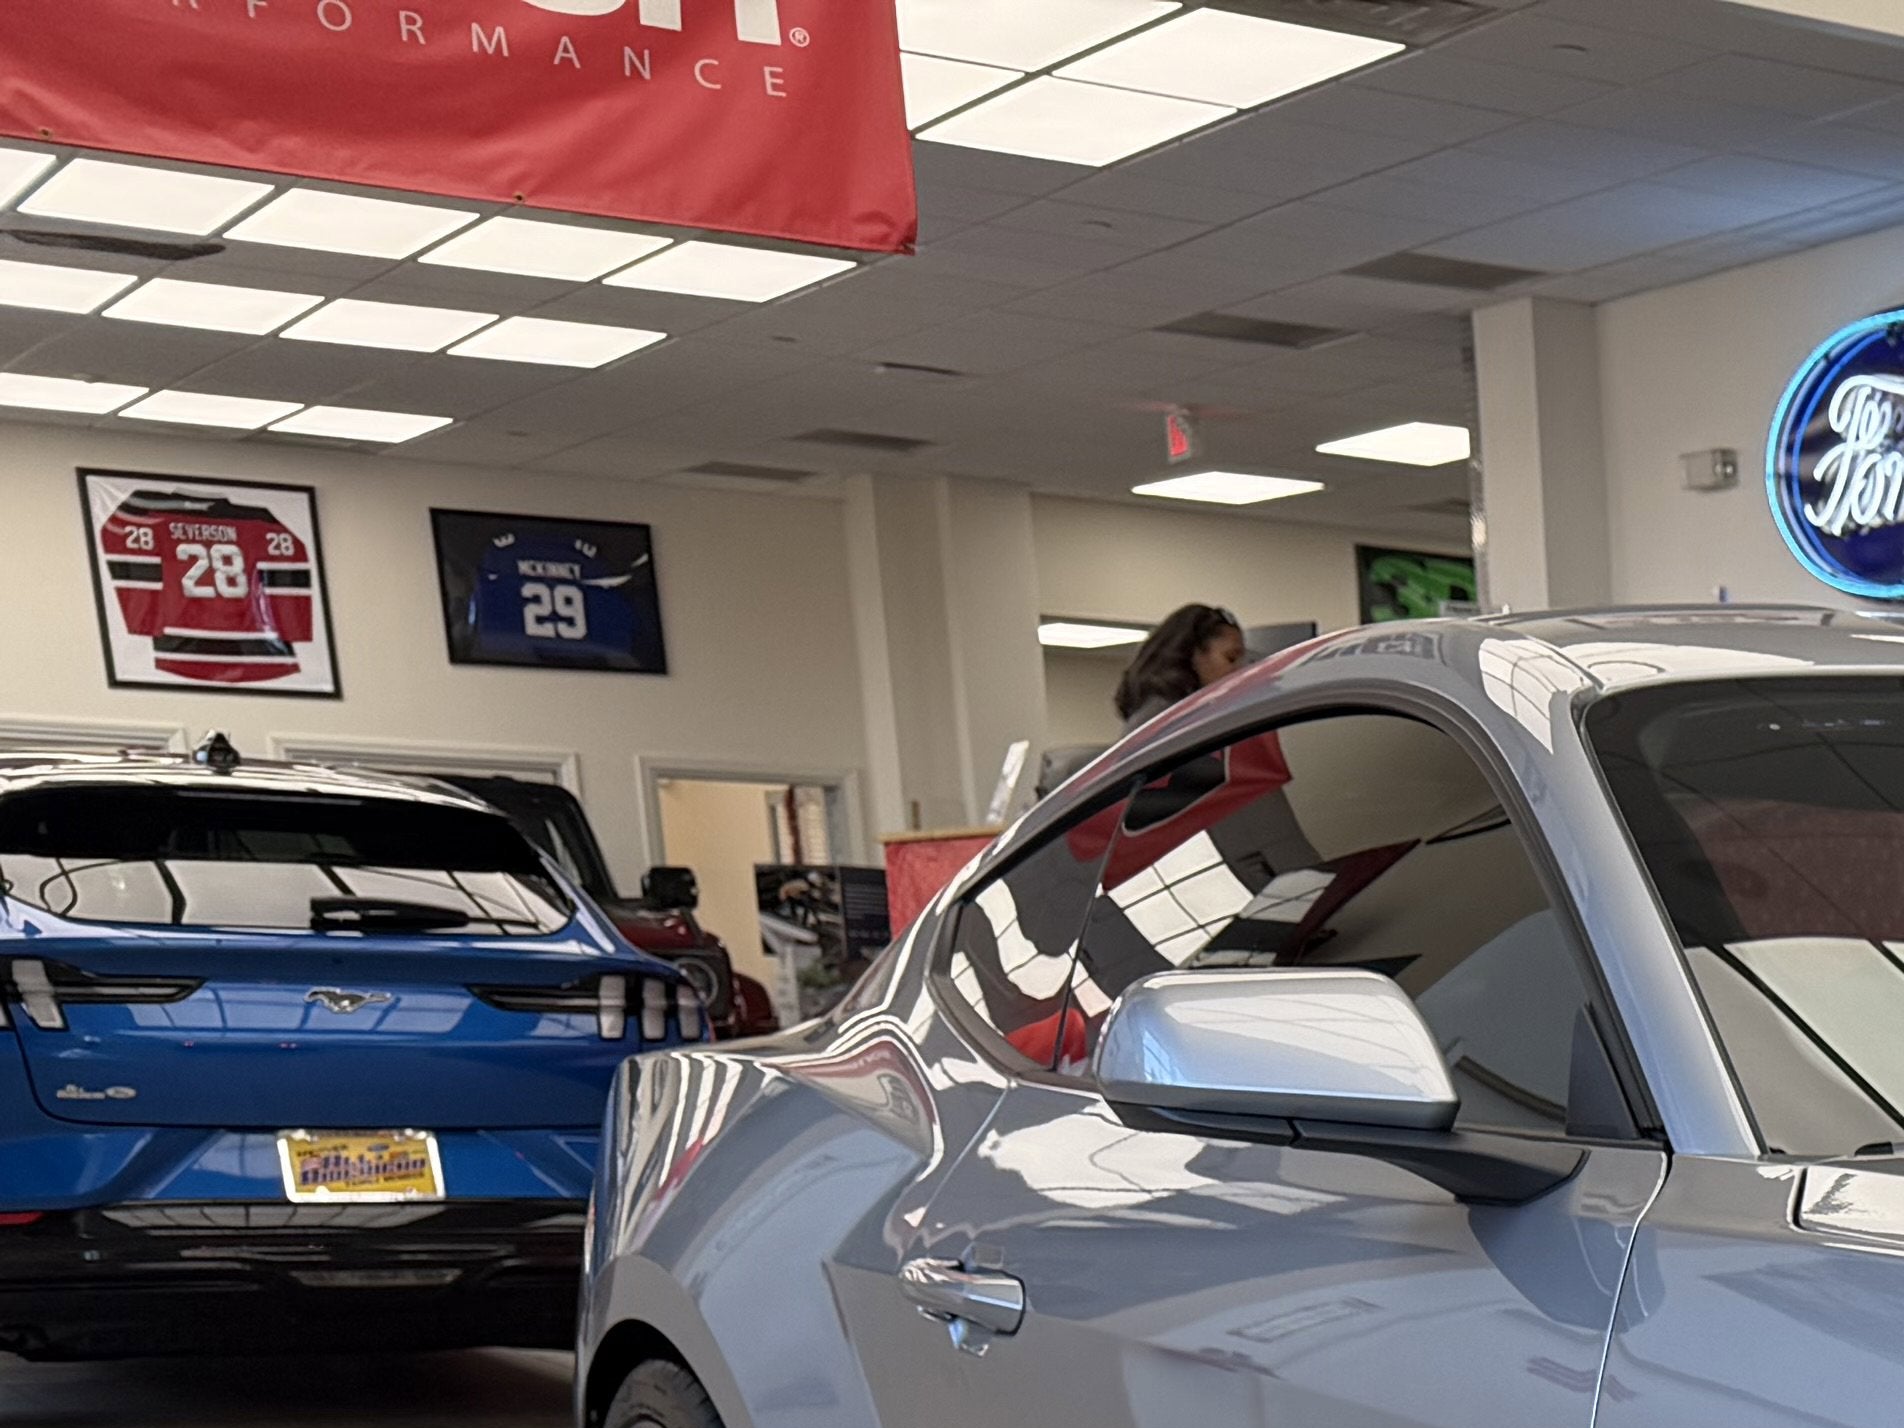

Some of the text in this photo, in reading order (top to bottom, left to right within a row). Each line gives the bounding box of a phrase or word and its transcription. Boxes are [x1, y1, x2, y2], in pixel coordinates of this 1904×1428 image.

[172, 0, 787, 97] FORMANCE
[124, 525, 154, 551] 28
[169, 521, 238, 543] SEVERSON
[265, 532, 295, 556] 28
[176, 543, 249, 598] 28
[520, 581, 588, 640] 29
